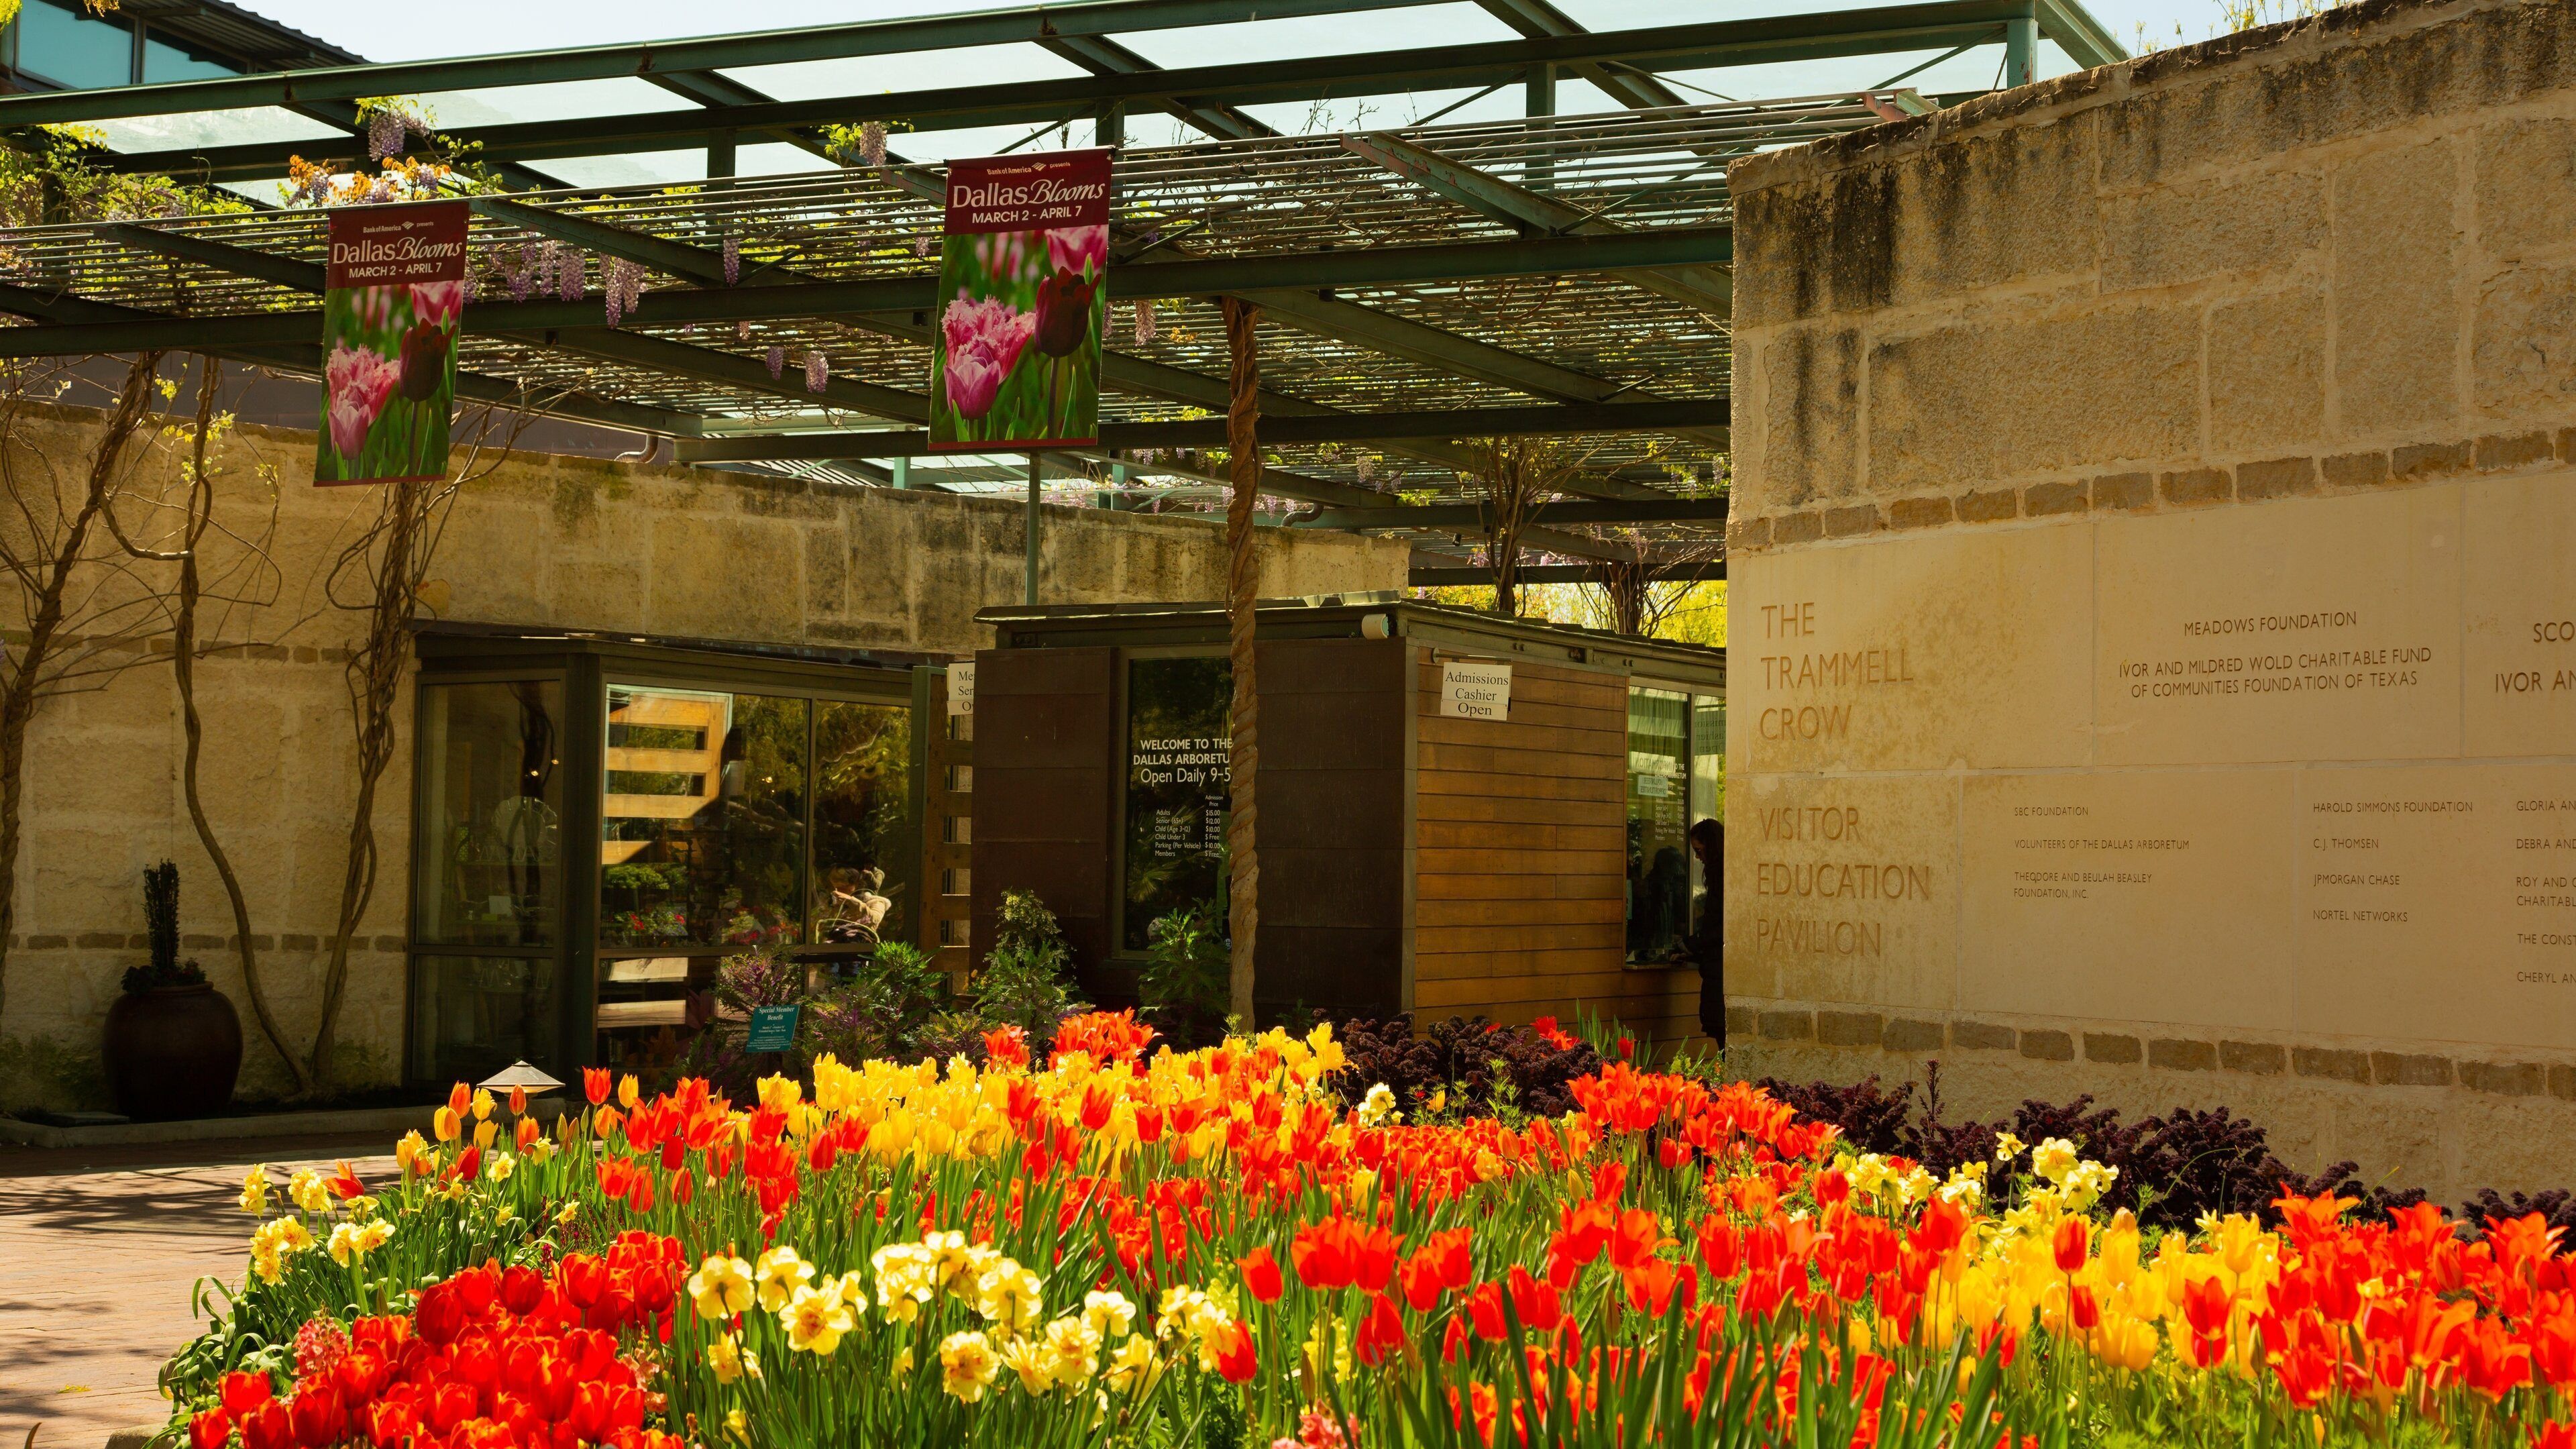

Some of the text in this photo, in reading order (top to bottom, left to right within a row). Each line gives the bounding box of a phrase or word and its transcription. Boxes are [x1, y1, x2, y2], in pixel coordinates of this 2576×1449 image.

[952, 178, 1106, 208] Dallas Blooms
[972, 211, 1019, 223] MARCH
[1022, 210, 1029, 221] 2
[1040, 207, 1071, 219] APRIL
[1075, 205, 1082, 217] 7
[332, 237, 462, 264] Dallas Blooms
[349, 266, 387, 278] MARCH
[390, 266, 396, 276] 2
[405, 264, 433, 275] APRIL
[436, 262, 442, 272] 7
[1761, 602, 1815, 639] THE
[2184, 610, 2357, 637] MEADOWS FOUNDATION
[2533, 621, 2575, 643] SCO
[2119, 647, 2431, 678] IVOR AND MILDRED WOLD CHARITABLE FUND
[1760, 649, 1914, 690] TRAMMELL
[959, 671, 975, 681] Me
[1445, 672, 1509, 686] Admissions
[2496, 669, 2576, 693] IVOR AN
[2131, 671, 2418, 698] OF COMMUNITIES FOUNDATION OF TEXAS
[958, 686, 974, 696] Ser
[1456, 688, 1497, 701] Cashier
[962, 701, 973, 711] O
[1458, 702, 1492, 716] Open
[1760, 705, 1851, 741] CROW
[1140, 738, 1233, 750] WELCOME TO THE
[1133, 753, 1230, 765] DALLAS ARBORETU
[1140, 767, 1231, 787] Open Daily 9-5
[2015, 806, 2089, 816] SBC FOUNDATION
[2313, 802, 2473, 813] HAROLD SIMMONS FOUNDATION
[2516, 800, 2576, 811] GLORIA AN
[1167, 825, 1178, 833] (Age
[1759, 806, 1862, 841] VISITOR
[1155, 842, 1171, 850] Parking
[2015, 839, 2190, 850] VOLUNTEERS OF THE DALLAS ARBORETUM
[2332, 839, 2379, 849] THOMSEN
[2516, 839, 2576, 849] DEBRA AND
[1758, 863, 1929, 900] EDUCATION
[2015, 872, 2152, 883] THEODORE AND BEULAH BEASLEY
[2314, 874, 2400, 887] JPMORGAN CHASE
[2516, 877, 2538, 887] ROY
[2543, 877, 2567, 888] AND
[2014, 888, 2089, 899] FOUNDATION, INC.
[2517, 896, 2576, 907] CHARITABL
[2313, 910, 2408, 922] NORTEL NETWORKS
[1756, 918, 1880, 957] PAVILION
[2517, 934, 2576, 945] THE CONST
[2517, 972, 2576, 983] CHERYL AN
